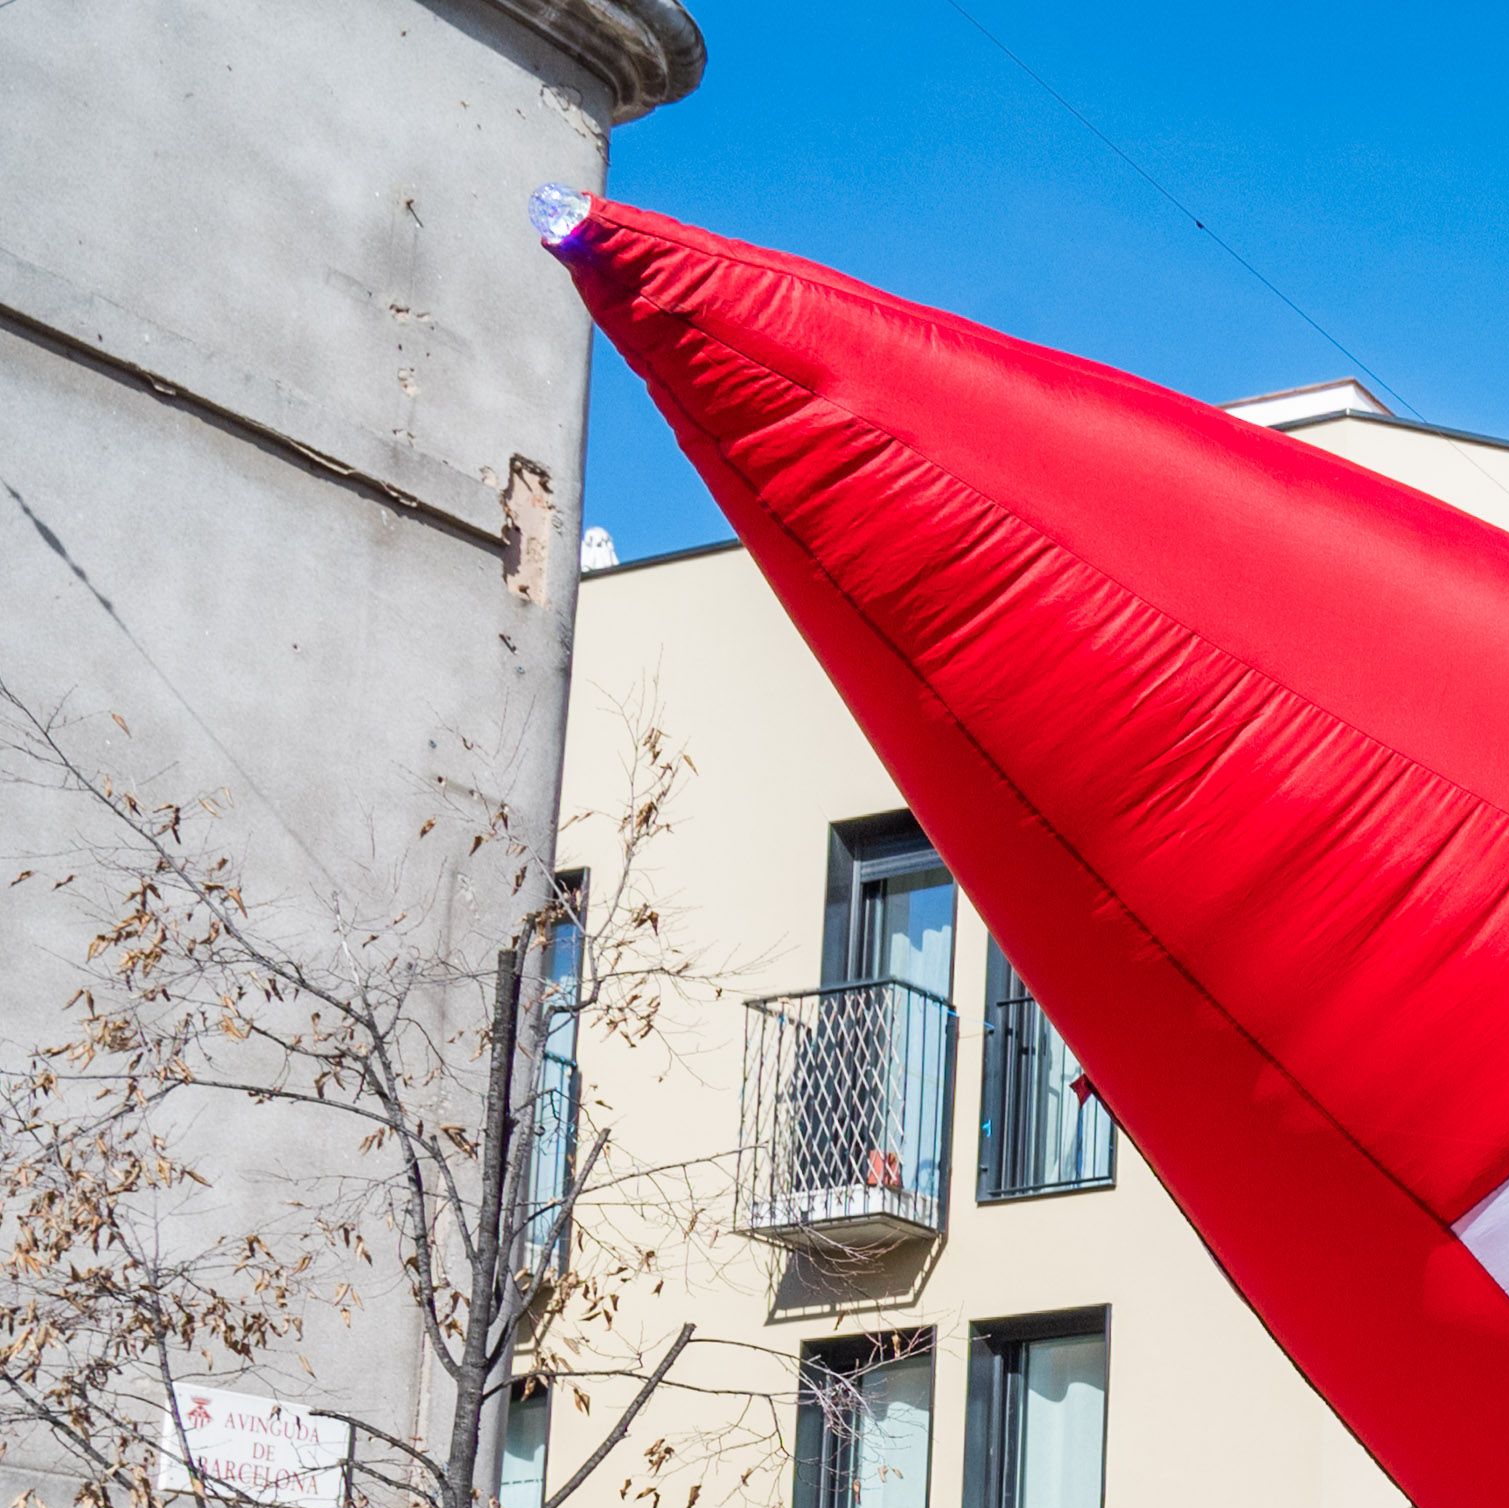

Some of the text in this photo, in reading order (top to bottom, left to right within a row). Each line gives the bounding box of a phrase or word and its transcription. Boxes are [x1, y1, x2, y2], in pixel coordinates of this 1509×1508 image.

[224, 1412, 321, 1446] AVINGUDA
[252, 1442, 276, 1462] DE
[196, 1454, 319, 1496] BARCELONA
